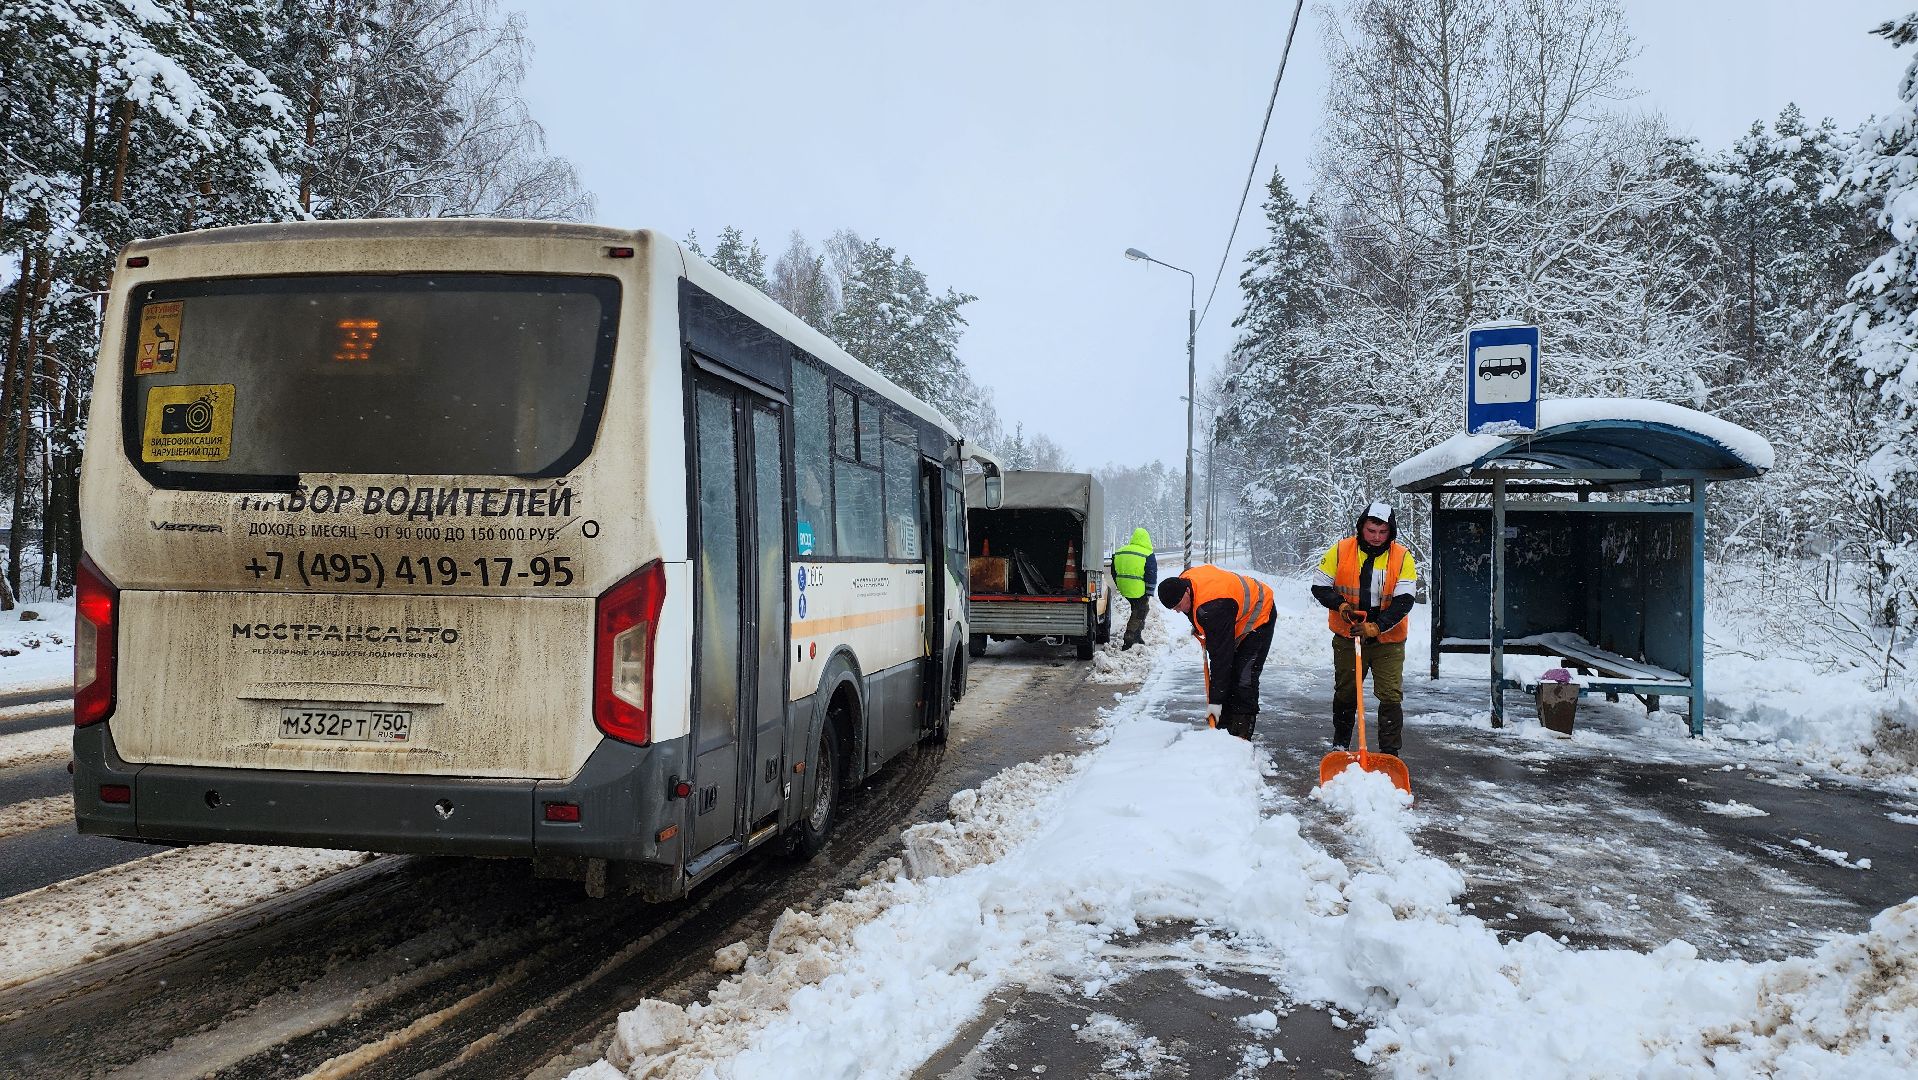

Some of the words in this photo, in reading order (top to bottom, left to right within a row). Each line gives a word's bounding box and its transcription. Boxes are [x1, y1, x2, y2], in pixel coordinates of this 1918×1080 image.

[151, 446, 201, 457] НАРУШЕНИЙ
[202, 447, 221, 457] ПДД
[363, 479, 572, 521] ВОДИТЕЛЕЙ
[249, 522, 295, 537] ДОХОД
[299, 522, 306, 536] В
[311, 524, 357, 540] МЕСЯЦ
[374, 526, 391, 539] ОТ
[395, 526, 411, 539] 90
[415, 527, 440, 540] 000
[445, 527, 465, 542] ДО
[470, 527, 494, 541] 150
[499, 528, 524, 541] 000
[529, 528, 560, 541] РУБ.
[245, 551, 284, 580] +7
[297, 550, 385, 588] (495)
[395, 556, 574, 588] 419-17-95
[232, 623, 458, 643] МОСТРАНСАВТО
[285, 713, 367, 736] М332РТ
[373, 714, 403, 730] 750
[378, 731, 393, 739] RUS
